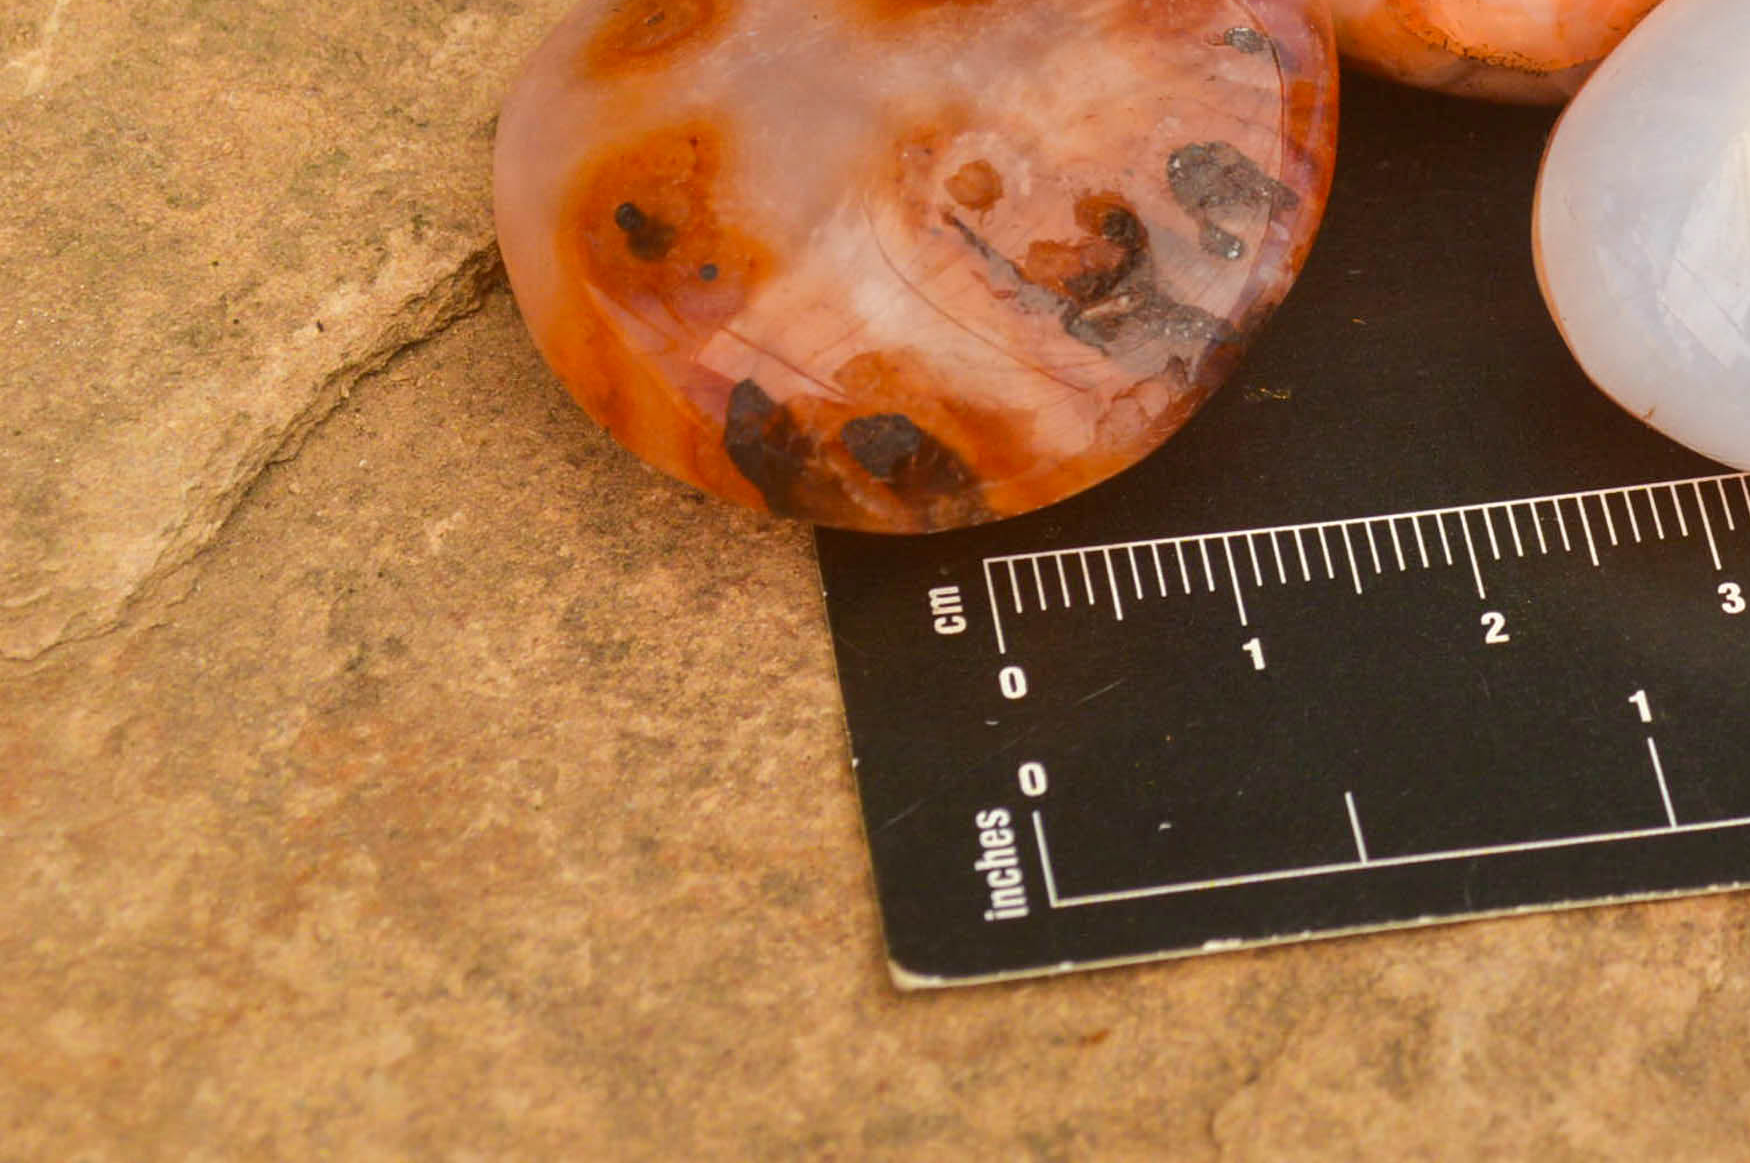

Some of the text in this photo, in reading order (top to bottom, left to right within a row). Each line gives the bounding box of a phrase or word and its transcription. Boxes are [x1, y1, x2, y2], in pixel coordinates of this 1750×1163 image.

[929, 586, 966, 635] cm
[999, 666, 1027, 699] 0
[1243, 638, 1265, 670] 1
[1481, 612, 1509, 644] 2
[1718, 582, 1746, 613] 3
[1019, 762, 1047, 796] 0
[1628, 690, 1652, 722] 1
[975, 808, 1028, 921] inches
